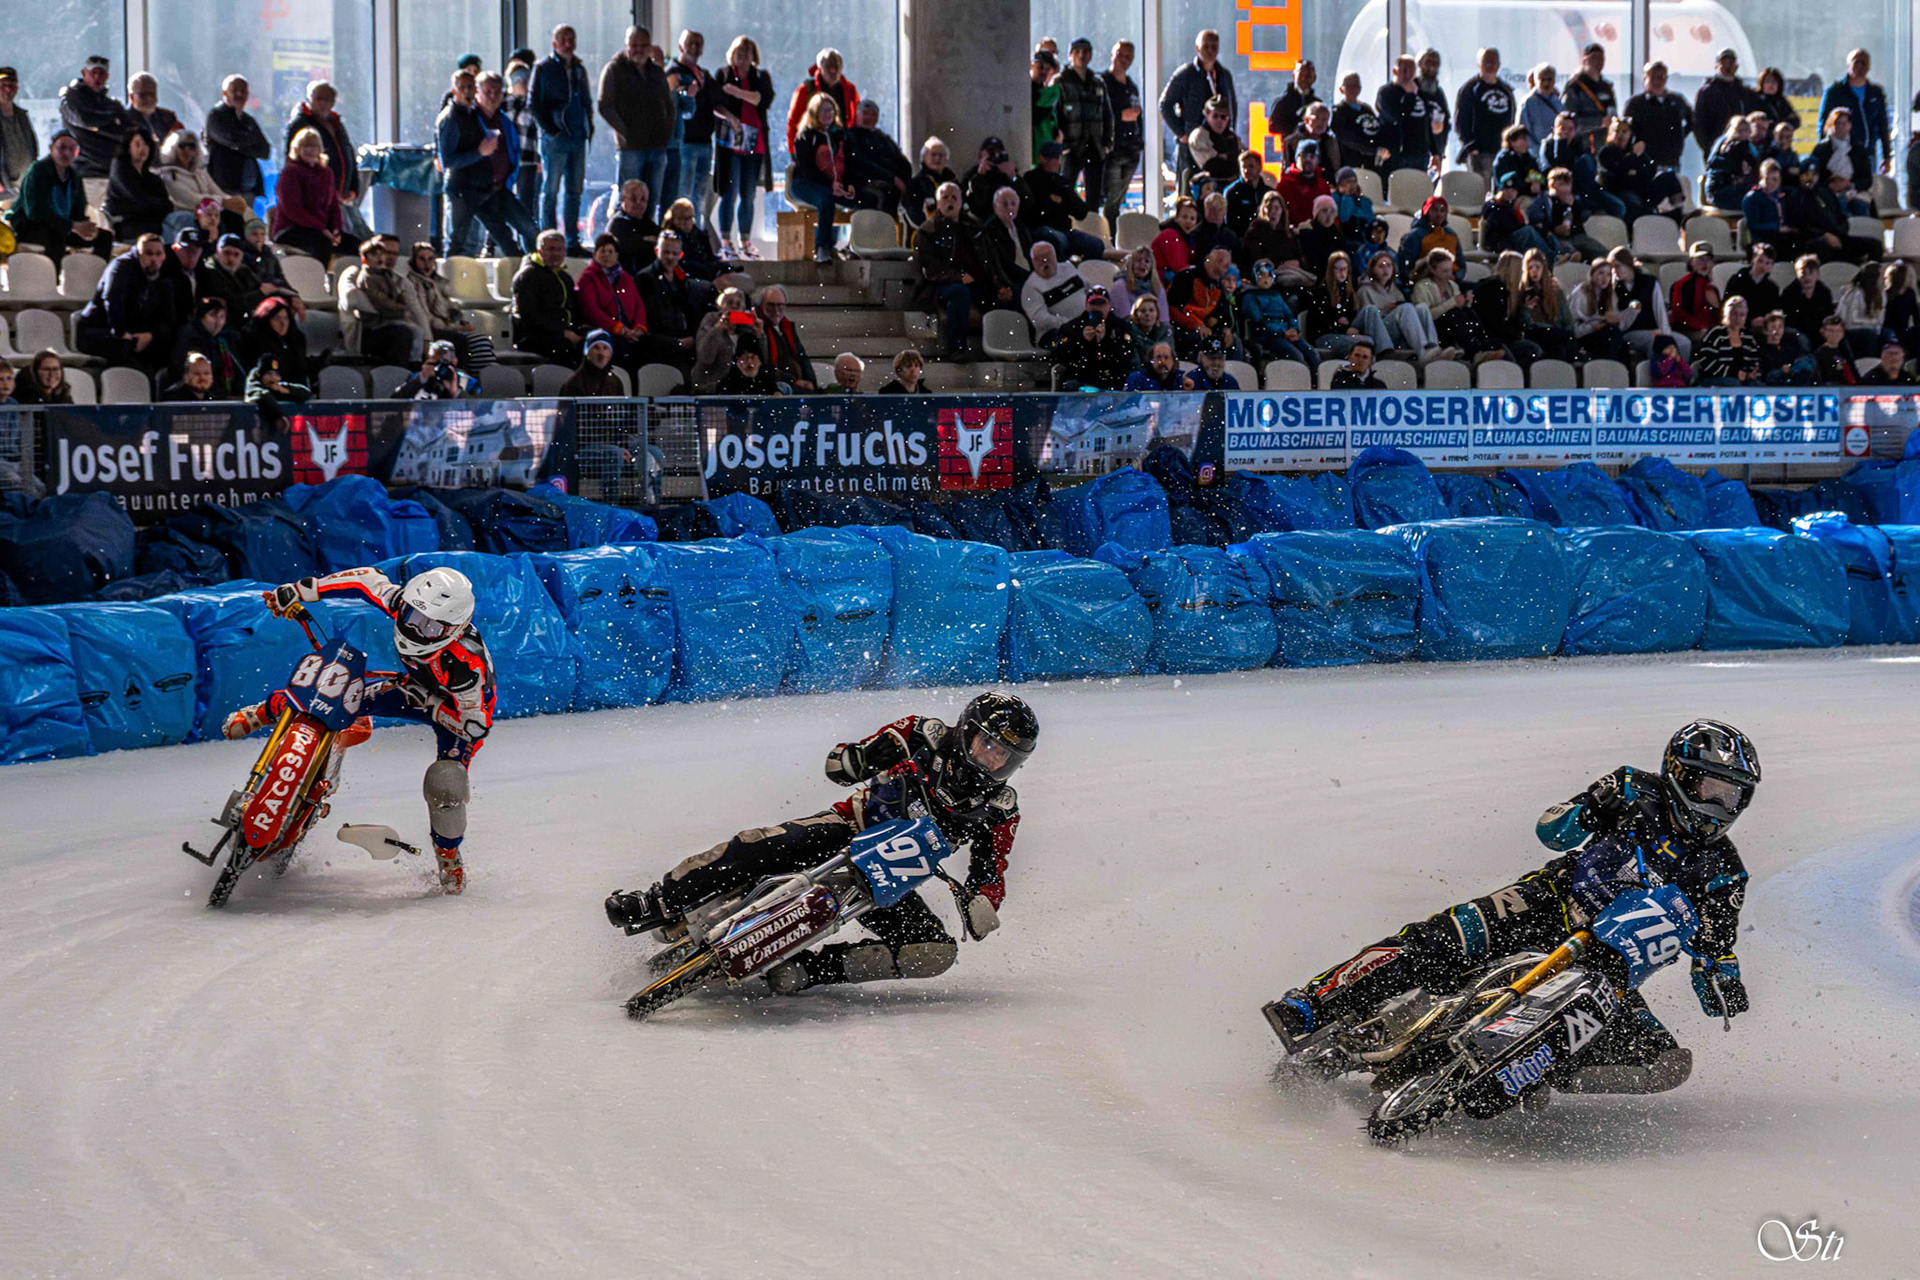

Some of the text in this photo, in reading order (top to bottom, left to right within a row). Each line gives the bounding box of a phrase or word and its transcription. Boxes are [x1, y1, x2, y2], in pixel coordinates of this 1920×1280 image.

[1227, 397, 1346, 428] MOSER
[1351, 396, 1469, 426] MOSER
[1473, 395, 1591, 425] MOSER
[1596, 394, 1715, 424] MOSER
[1720, 394, 1839, 422] MOSER
[968, 433, 983, 452] JF
[1229, 432, 1345, 448] BAUMASCHINEN
[1352, 430, 1468, 446] BAUMASCHINEN
[1474, 429, 1590, 445] BAUMASCHINEN
[1597, 427, 1713, 443] BAUMASCHINEN
[1720, 426, 1838, 442] BAUMASCHINEN
[57, 429, 282, 495] Josef Fuchs
[705, 420, 927, 480] Josef Fuchs
[311, 698, 334, 715] FIM
[876, 836, 931, 877] 97
[867, 860, 890, 887] FIM
[728, 905, 812, 959] NORDMALINGS
[1612, 896, 1681, 965] 719
[1620, 936, 1644, 966] FIM
